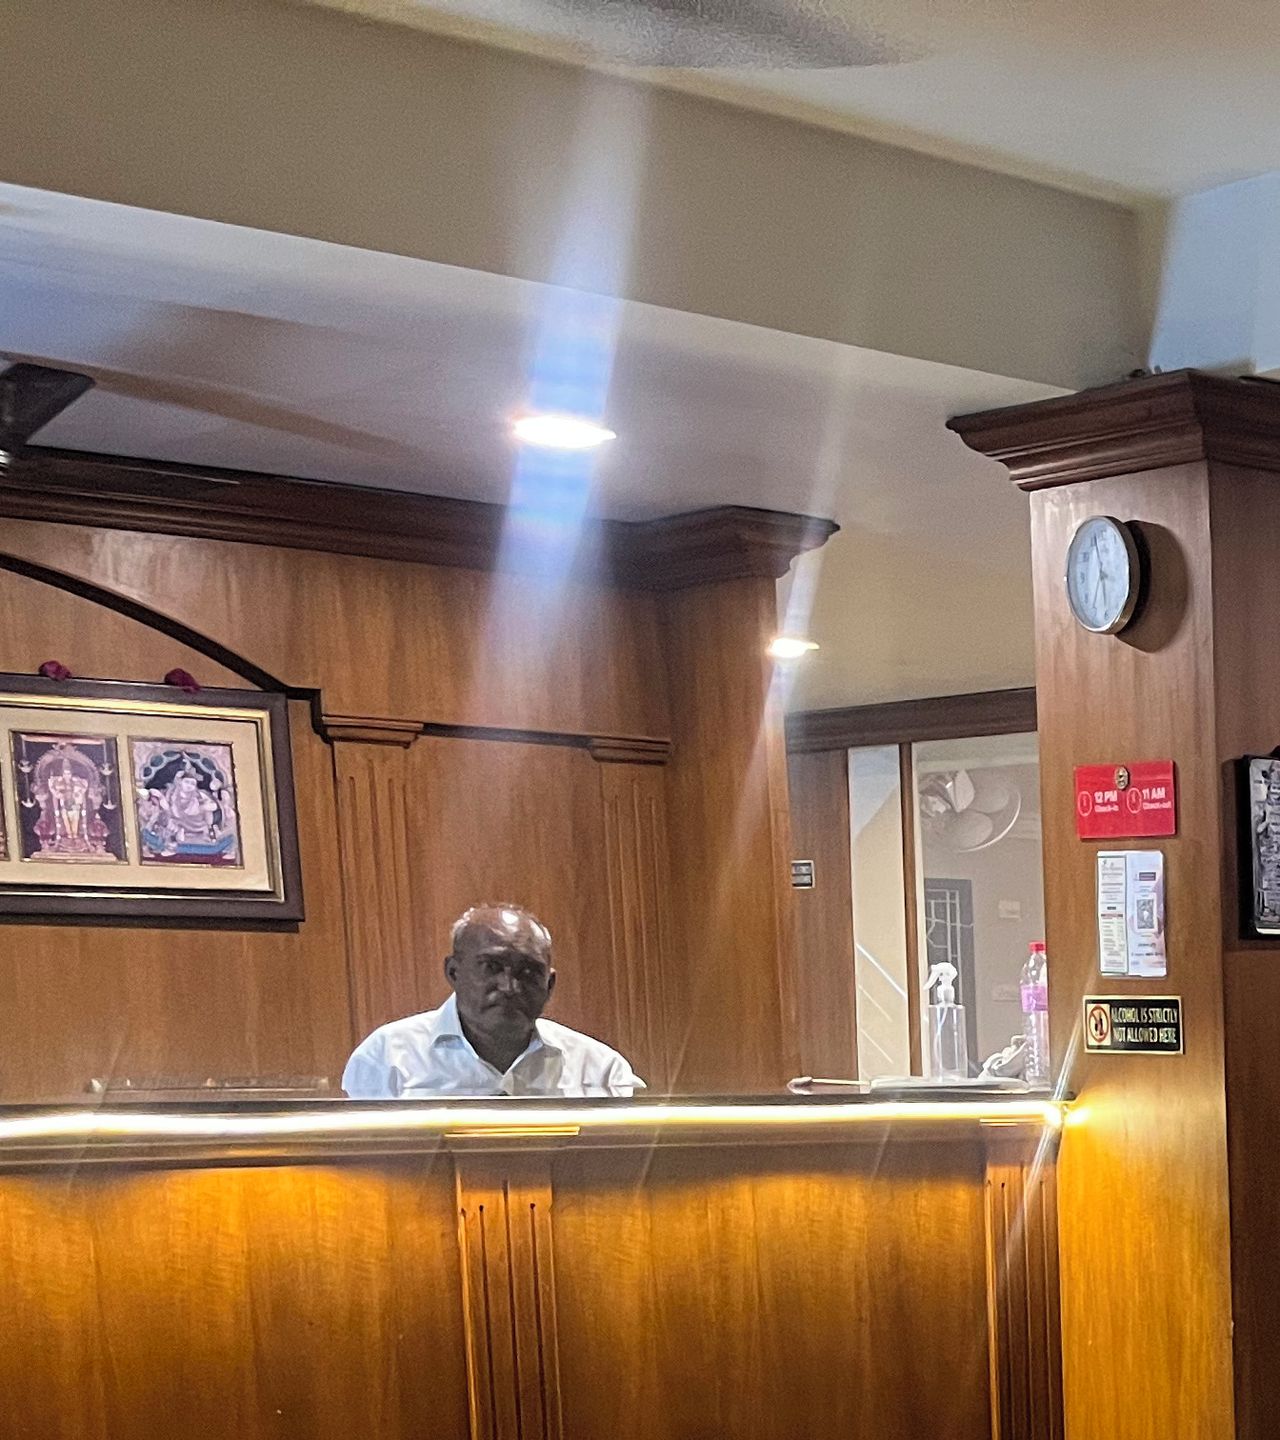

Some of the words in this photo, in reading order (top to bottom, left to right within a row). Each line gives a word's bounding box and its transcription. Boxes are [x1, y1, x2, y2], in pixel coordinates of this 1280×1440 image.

[1094, 792, 1103, 804] 12
[1104, 790, 1118, 802] PM
[1151, 787, 1166, 799] AM
[1111, 1007, 1140, 1023] ALCOHOL
[1140, 1007, 1147, 1023] IS
[1148, 1007, 1178, 1023] STRICTLY
[1113, 1027, 1126, 1043] NOT
[1126, 1027, 1158, 1043] ALLOWED
[1159, 1027, 1177, 1043] HERE
